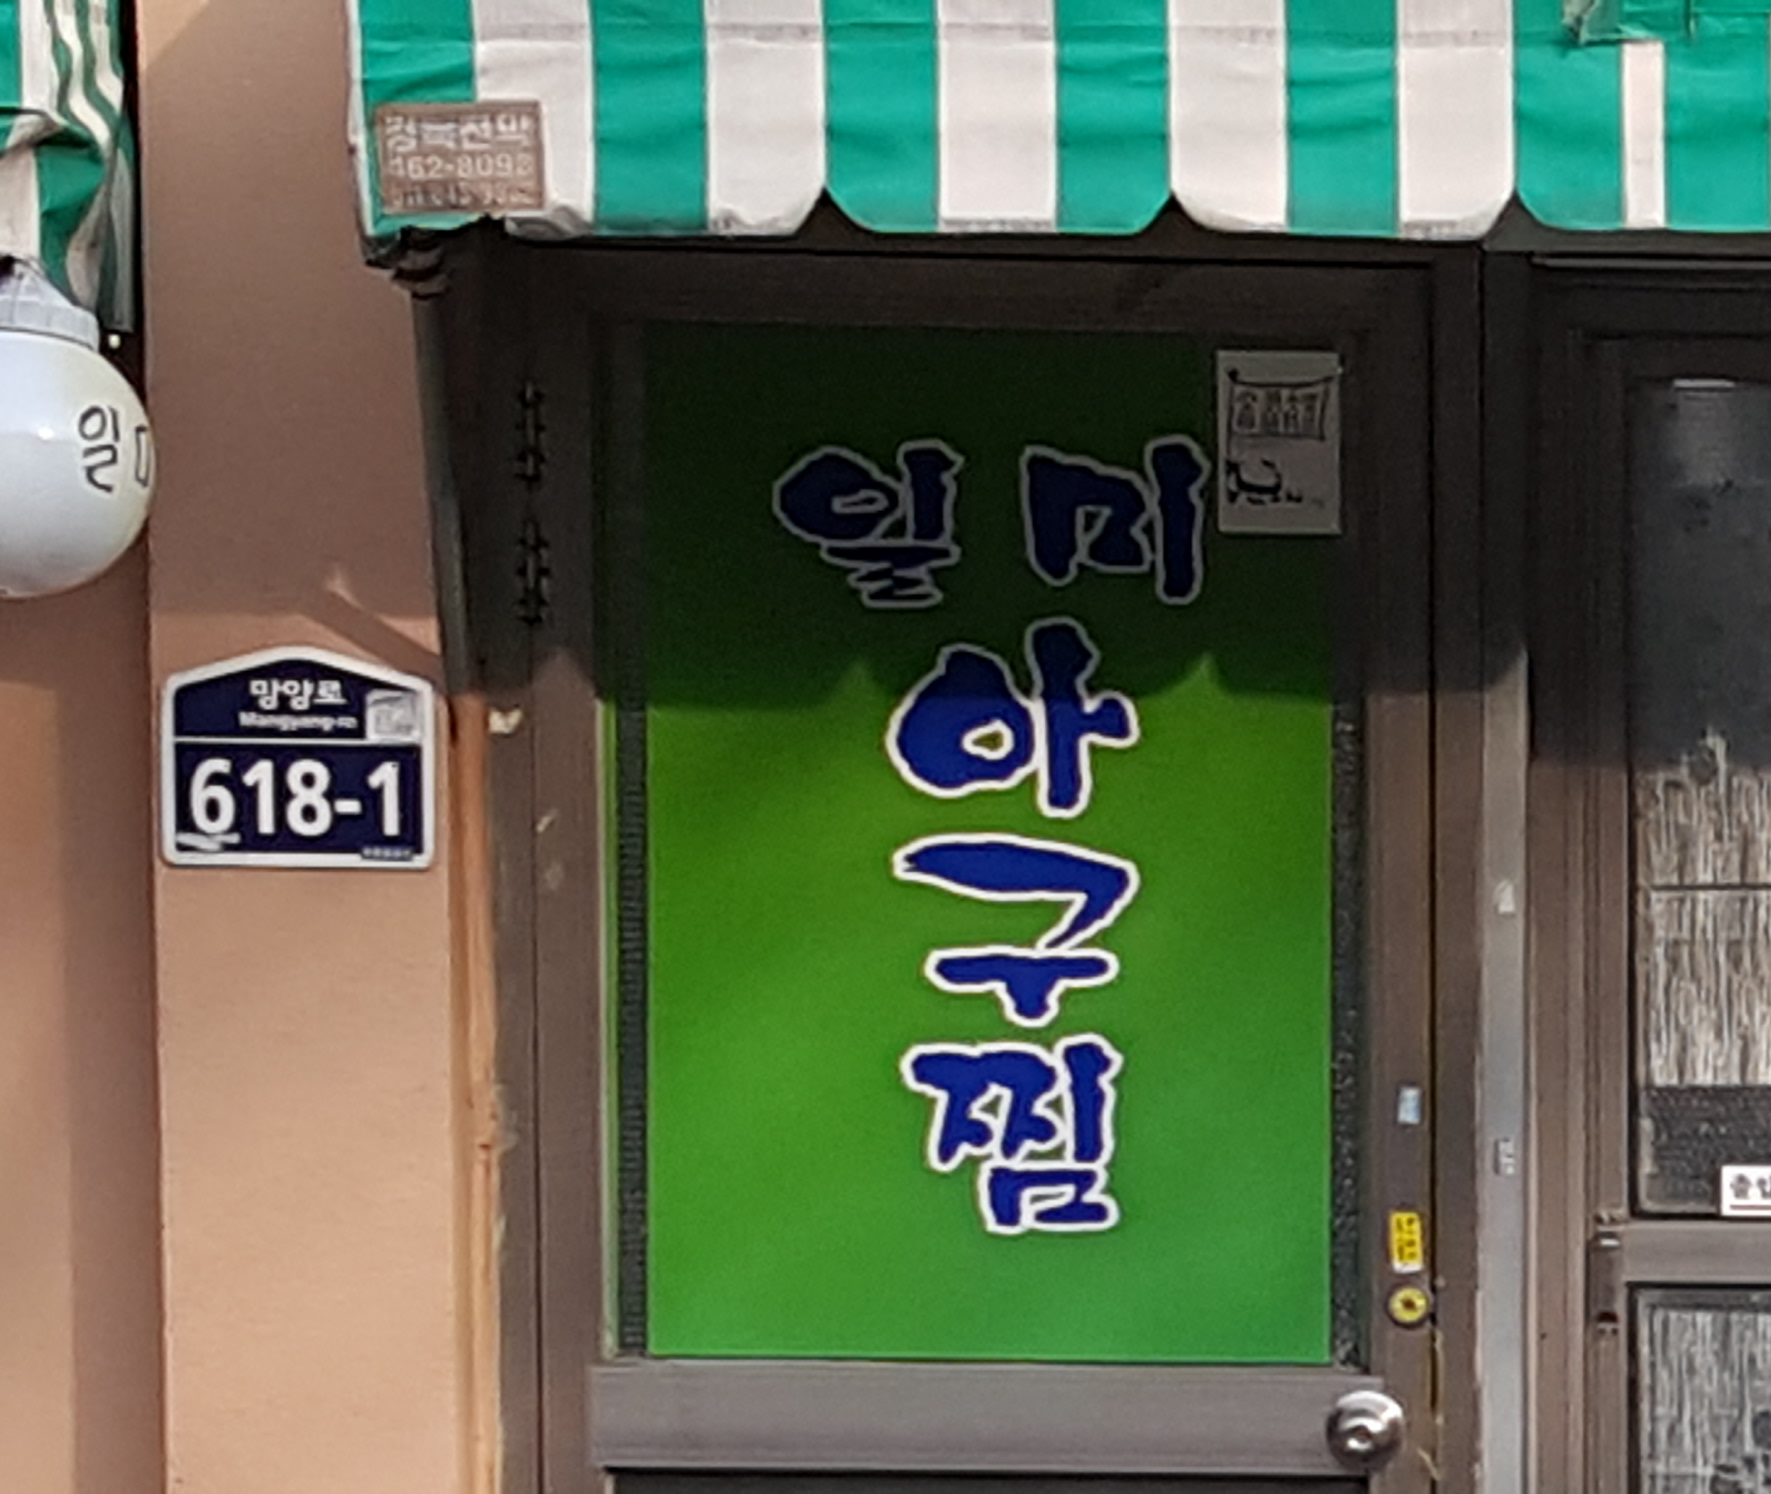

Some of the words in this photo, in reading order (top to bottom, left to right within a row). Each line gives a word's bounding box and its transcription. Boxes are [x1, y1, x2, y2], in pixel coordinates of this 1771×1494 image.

[250, 679, 348, 711] 망양로
[190, 757, 400, 837] 618-1
[884, 616, 1140, 1234] 아구찜
